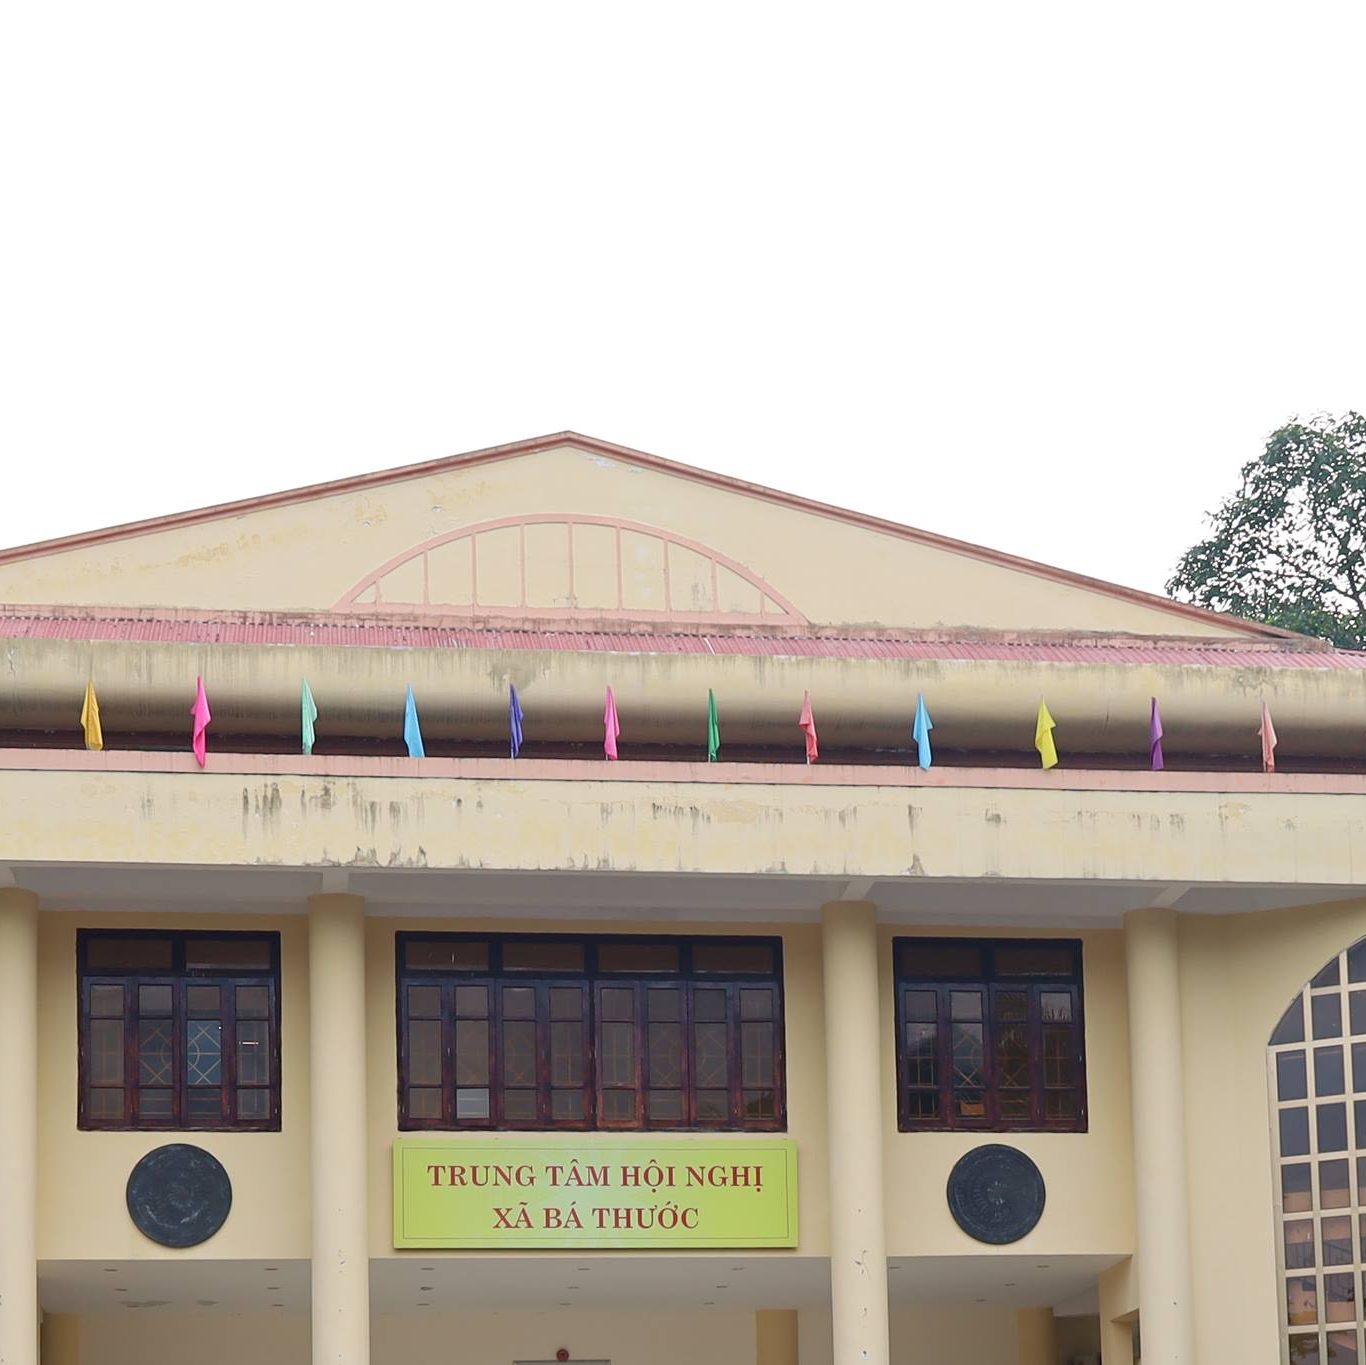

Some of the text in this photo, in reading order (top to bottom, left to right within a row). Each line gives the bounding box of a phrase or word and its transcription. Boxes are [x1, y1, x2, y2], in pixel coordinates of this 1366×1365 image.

[427, 1158, 764, 1193] TRUNG TÂM HỘI NGHỊ
[492, 1200, 700, 1230] XÃ BÁ THƯỚC
